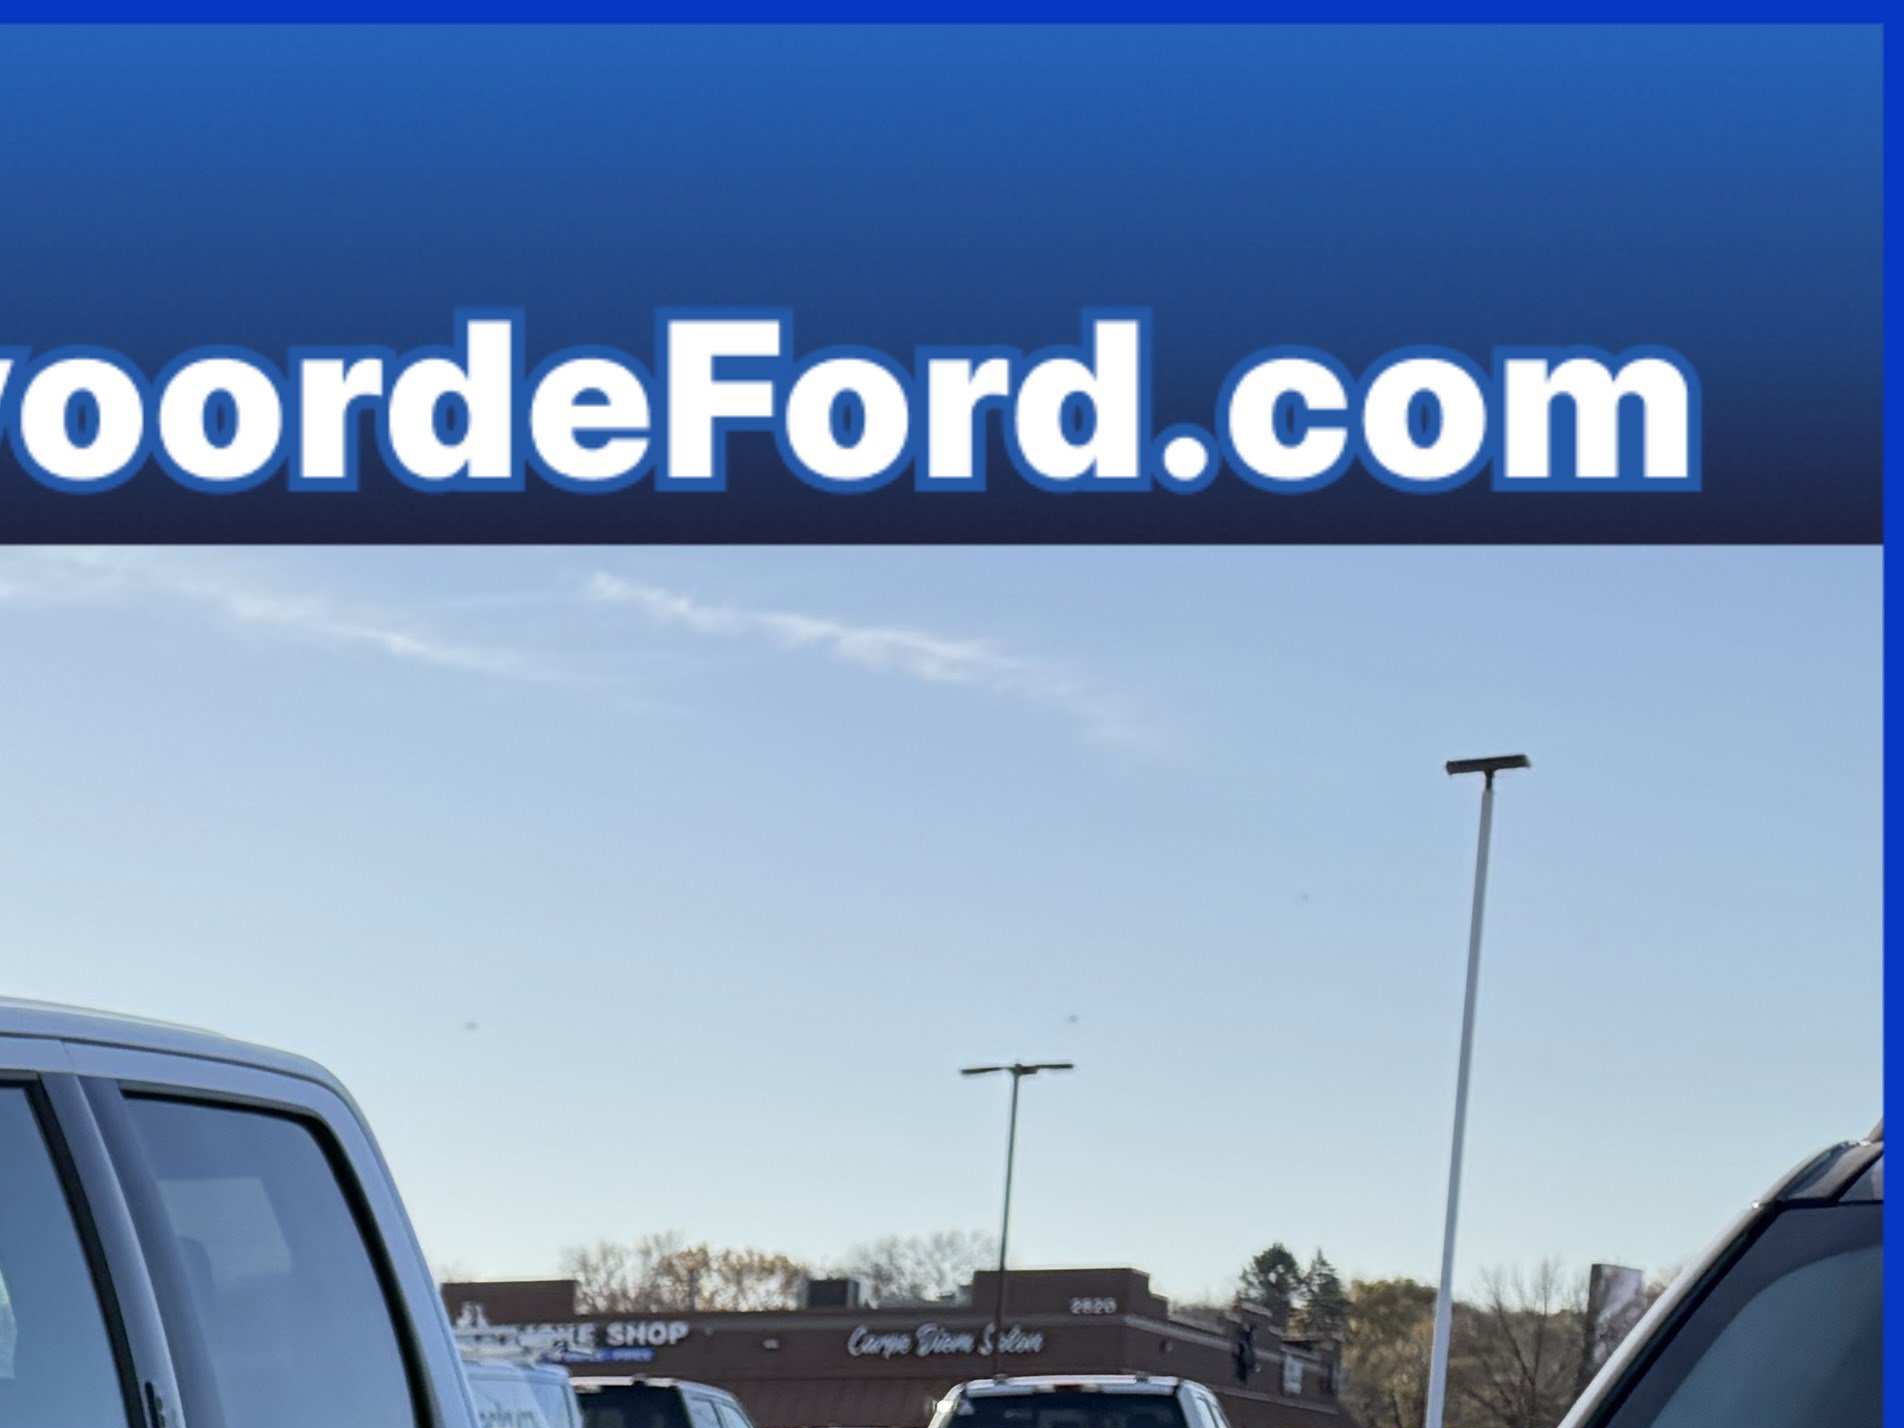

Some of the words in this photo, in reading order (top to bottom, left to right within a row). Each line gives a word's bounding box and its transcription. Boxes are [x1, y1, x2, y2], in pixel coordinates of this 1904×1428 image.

[605, 1321, 690, 1346] SHOP
[847, 1324, 912, 1359] Carpe
[914, 1322, 975, 1357] Diem
